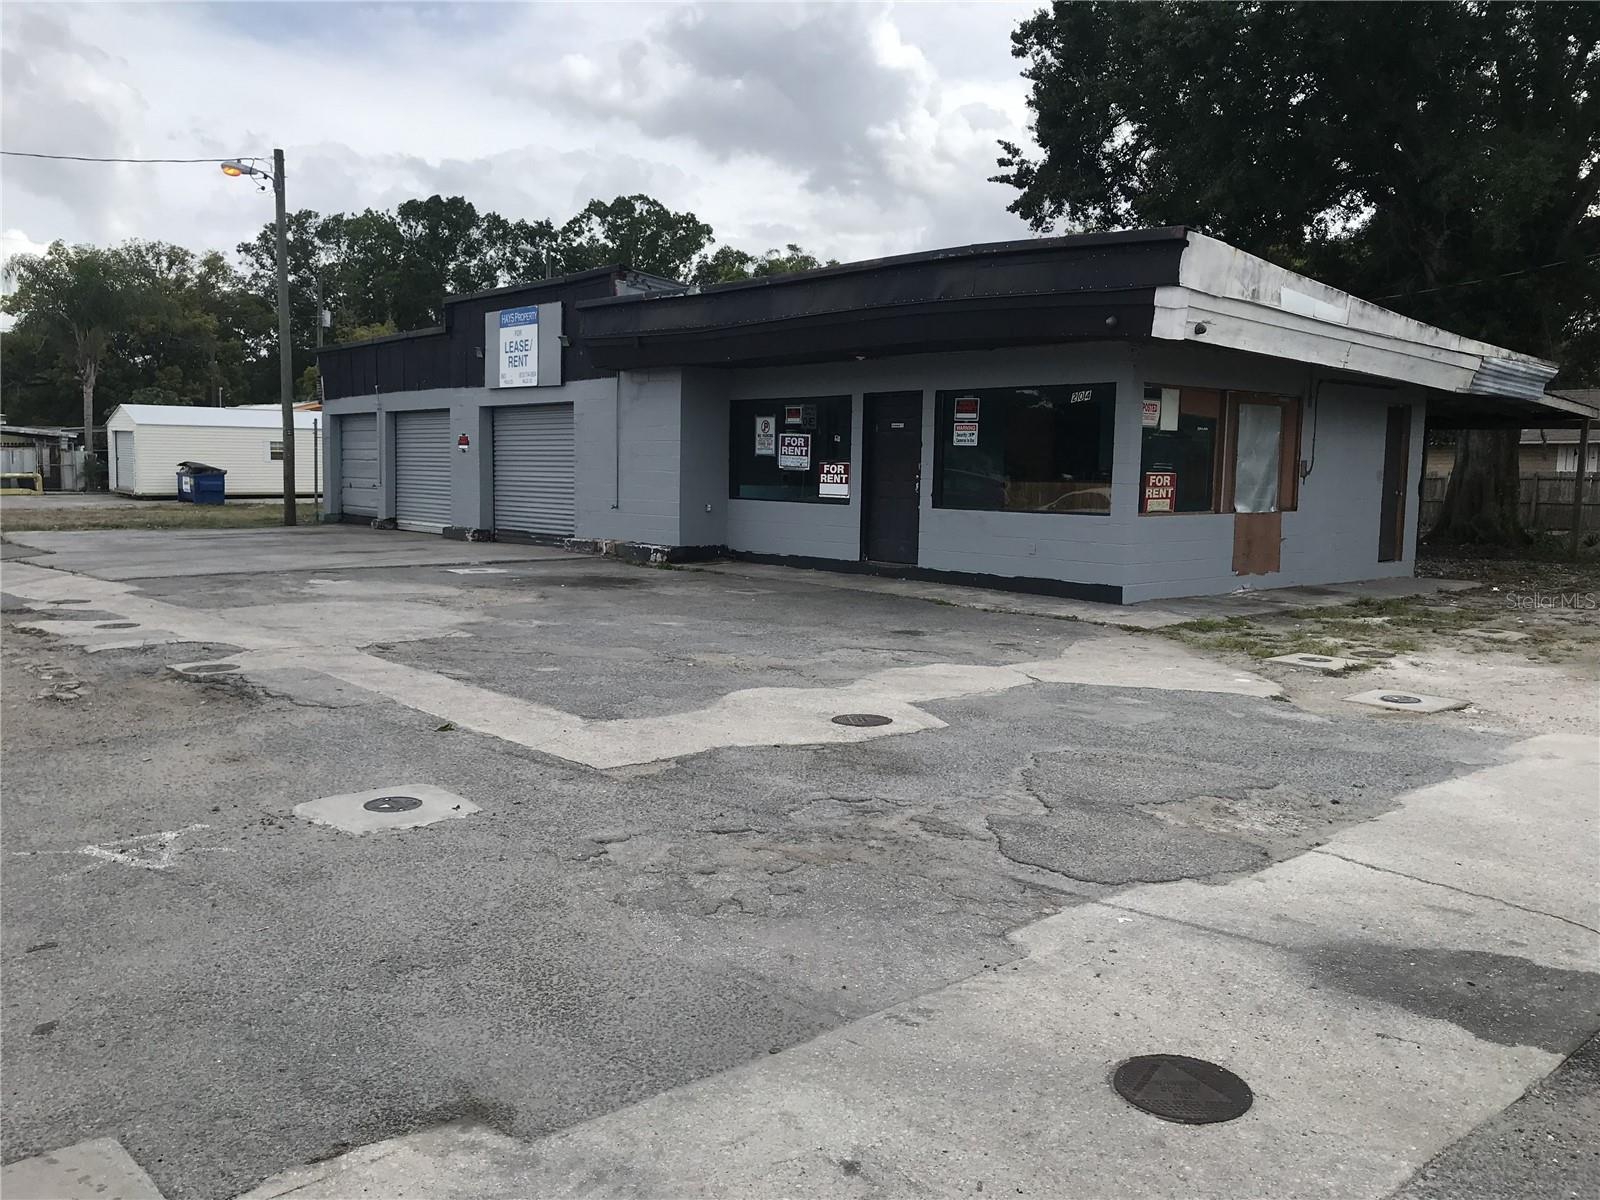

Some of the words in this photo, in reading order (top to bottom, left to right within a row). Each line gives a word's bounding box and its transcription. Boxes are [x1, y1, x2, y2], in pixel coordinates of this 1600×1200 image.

[501, 313, 514, 324] HAYS
[504, 338, 533, 354] LEASE/
[508, 354, 529, 369] RENT
[784, 437, 805, 446] FOR
[781, 447, 807, 456] RENT
[823, 464, 845, 474] FOR
[820, 474, 848, 484] RENT
[1149, 475, 1171, 486] FOR
[1145, 487, 1174, 498] RENT
